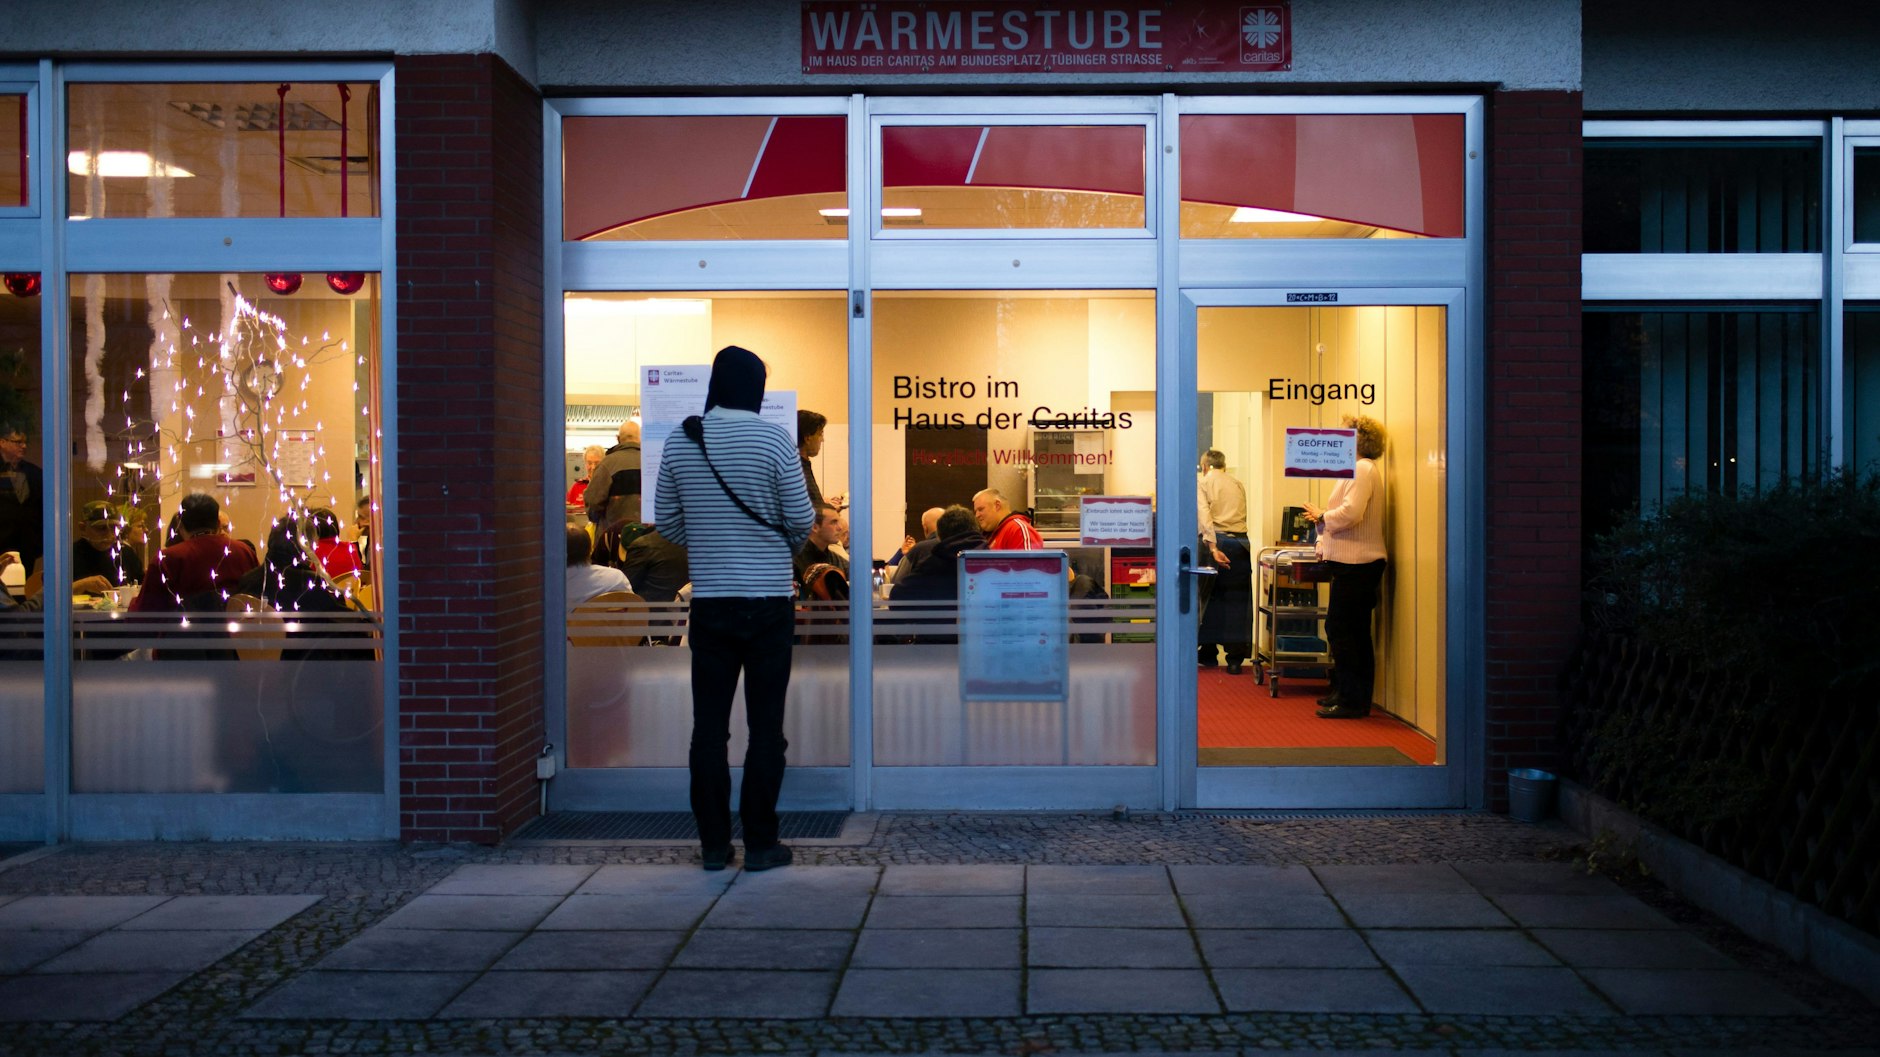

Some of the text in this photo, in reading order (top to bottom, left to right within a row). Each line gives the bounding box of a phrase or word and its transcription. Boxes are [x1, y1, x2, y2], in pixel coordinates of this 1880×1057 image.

[808, 4, 1163, 51] WÄRMESTUBE
[809, 55, 823, 67] IM
[826, 55, 857, 67] HAUS
[861, 55, 883, 67] DER
[888, 55, 935, 67] CARITAS
[938, 55, 957, 66] AM
[961, 55, 1041, 66] BUNDESPLATZ
[1051, 52, 1107, 65] TÜBINGER
[1110, 54, 1163, 65] STRASSE
[1243, 50, 1281, 62] caritas
[893, 375, 1019, 399] Bistro im
[1269, 378, 1375, 406] Eingang
[893, 406, 1133, 430] Haus der Caritas
[1298, 439, 1343, 447] GEÖFFNET
[992, 448, 1113, 465] Willkommen!
